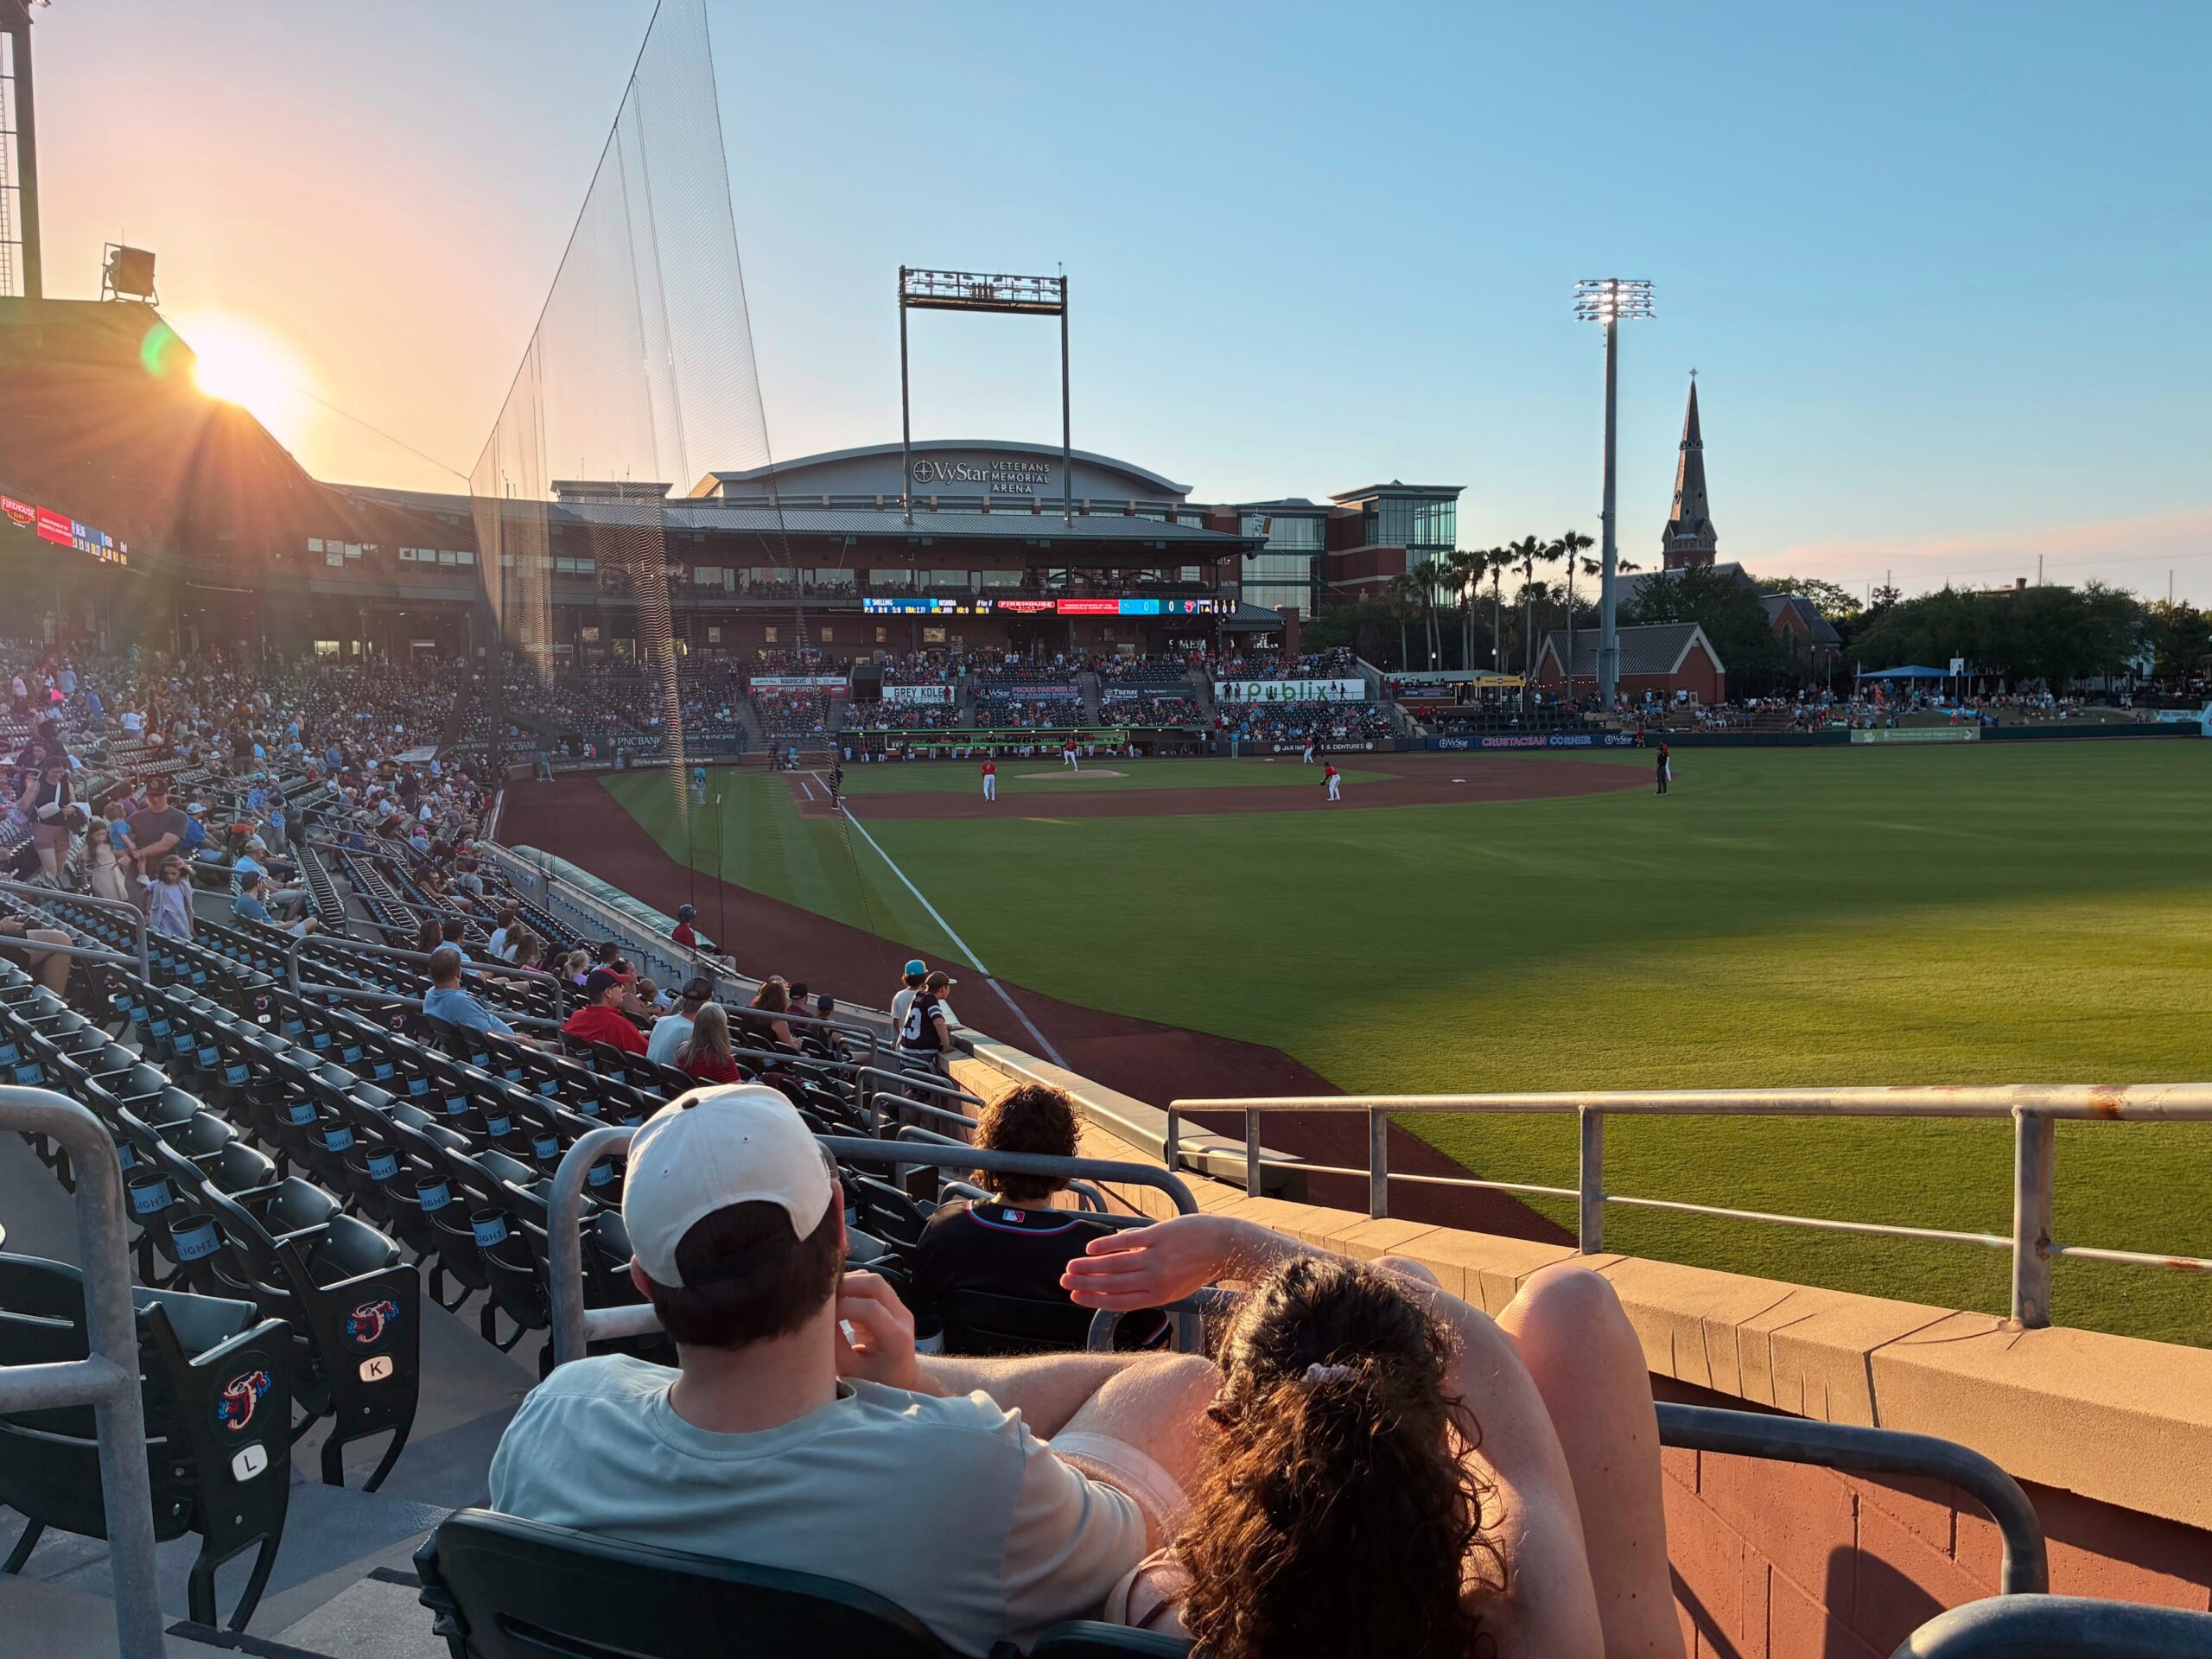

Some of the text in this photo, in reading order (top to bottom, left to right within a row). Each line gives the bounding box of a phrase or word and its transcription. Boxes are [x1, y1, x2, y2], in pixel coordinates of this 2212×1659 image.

[934, 461, 988, 485] VyStar
[991, 461, 1050, 473] VETERANS
[991, 473, 1050, 484] MEMORIAL
[992, 484, 1033, 493] ARENA
[3, 499, 35, 519] FIREHOUSE
[1168, 601, 1174, 612] 0
[894, 688, 917, 697] GREY
[988, 689, 1010, 697] VyStar
[1248, 682, 1328, 702] Publix
[617, 735, 664, 747] PNC BANK
[1447, 738, 1469, 747] VyStar
[1481, 735, 1592, 747] CRUSTACEAN CORNER
[1612, 734, 1633, 744] VyStar
[370, 1362, 383, 1376] K
[244, 1456, 257, 1472] L
